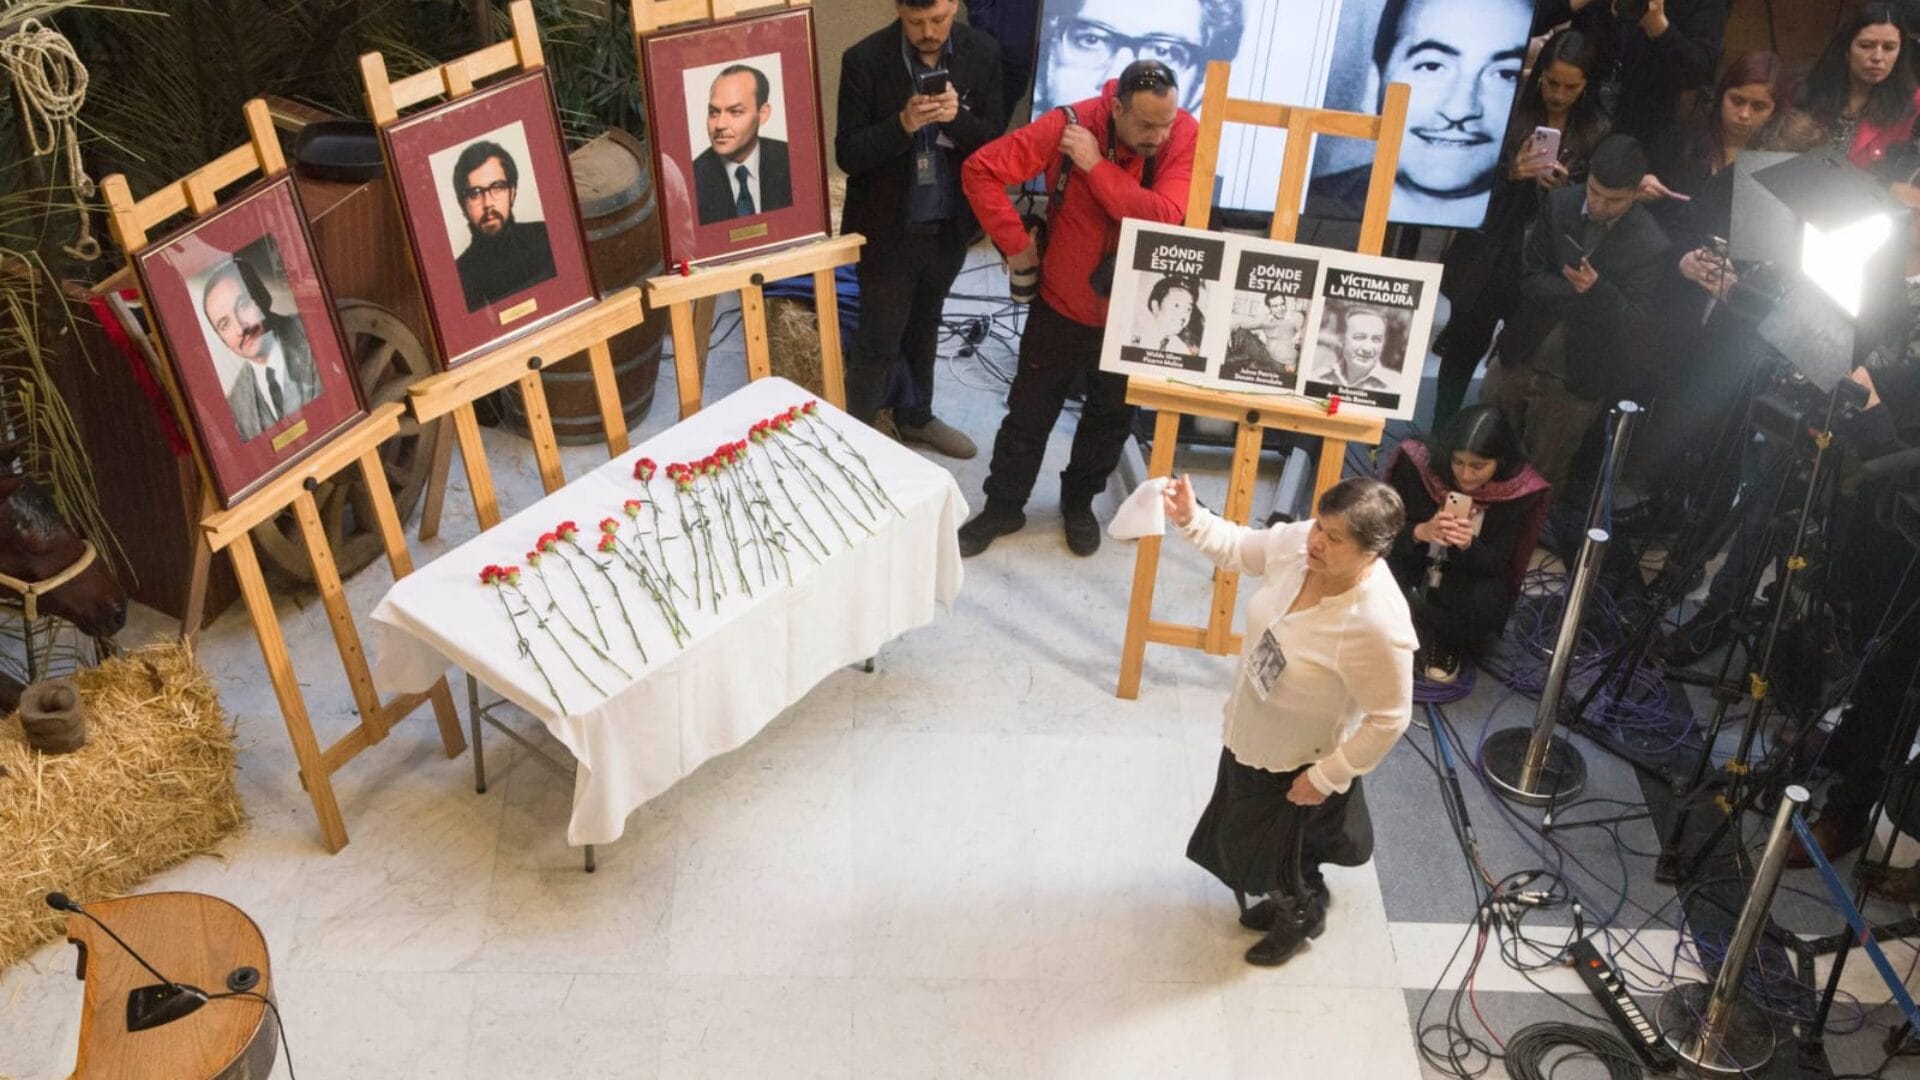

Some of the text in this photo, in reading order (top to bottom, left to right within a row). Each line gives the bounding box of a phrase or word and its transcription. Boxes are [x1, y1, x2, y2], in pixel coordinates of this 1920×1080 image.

[1151, 245, 1206, 262] ¿DÓNDE
[1151, 258, 1203, 275] ESTÁN?
[1249, 264, 1303, 281] ¿DÓNDE
[1248, 277, 1300, 294] ESTÁN?
[1340, 273, 1410, 294] VÍCTIMA DE
[1330, 284, 1414, 306] LA DICTADURA
